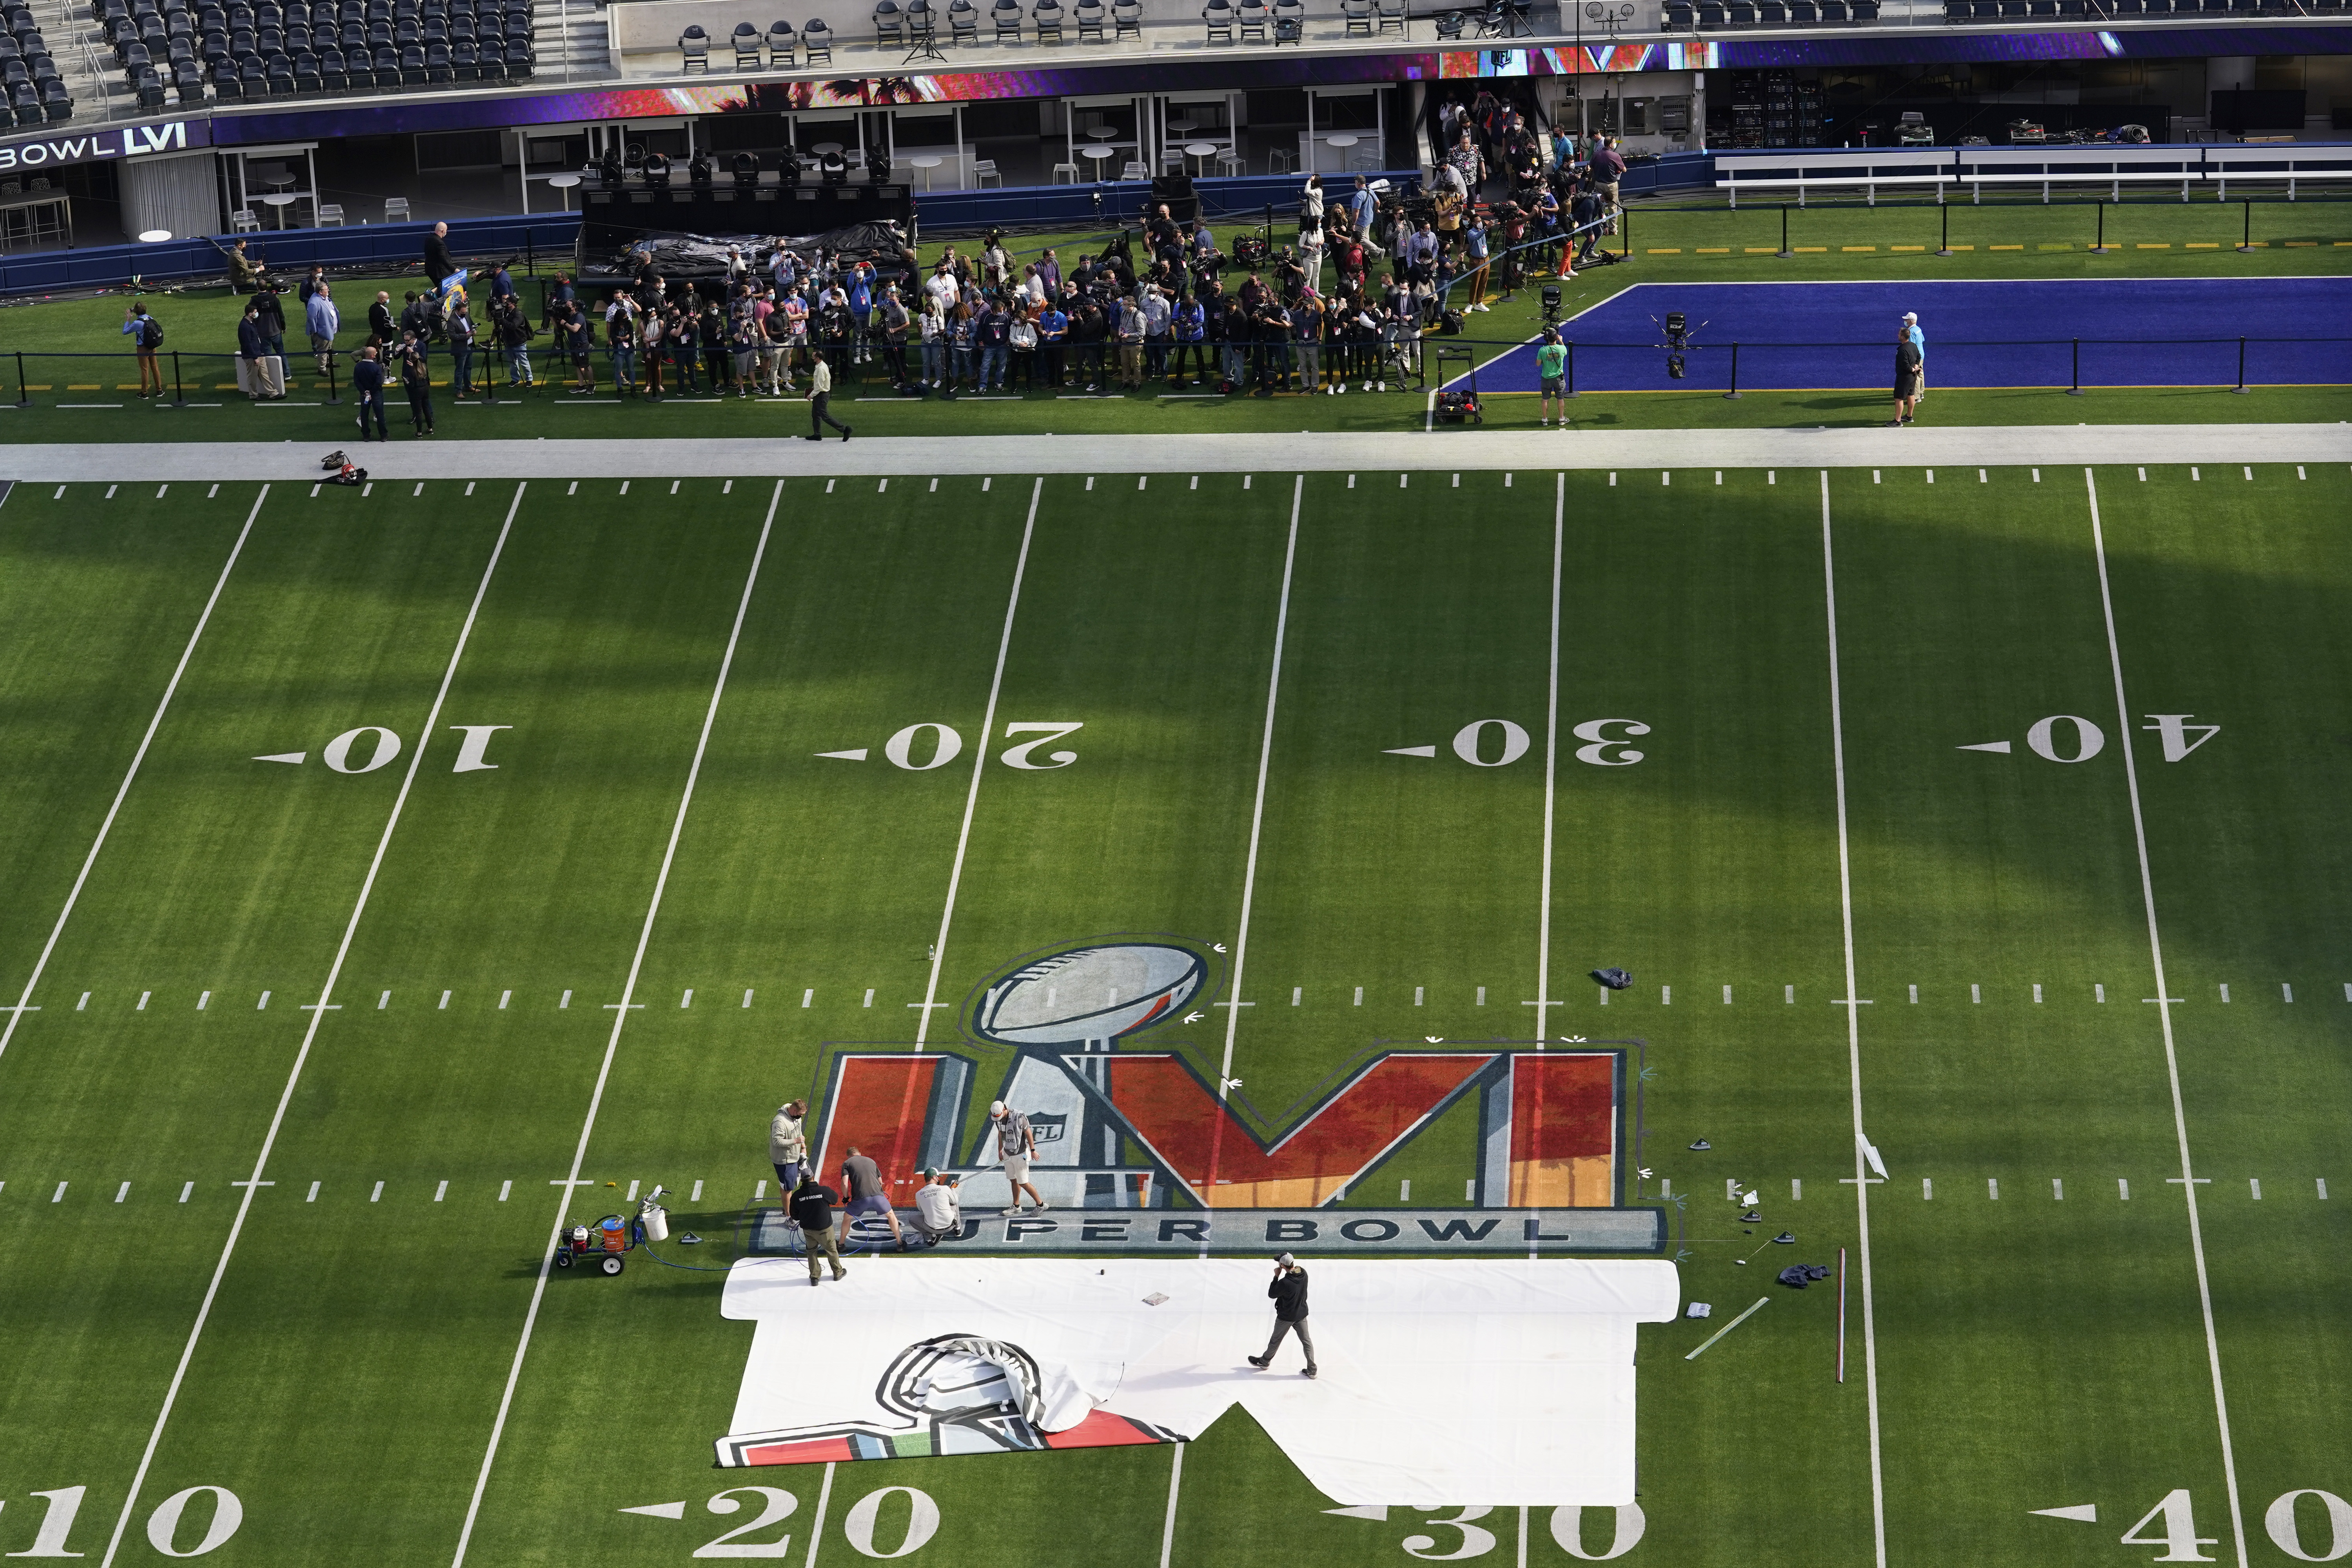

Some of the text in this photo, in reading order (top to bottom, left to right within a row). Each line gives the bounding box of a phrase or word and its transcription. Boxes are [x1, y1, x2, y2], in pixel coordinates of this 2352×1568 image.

[123, 122, 186, 156] LVI
[1029, 1126, 1058, 1141] FL
[1263, 1218, 1571, 1243] BOWL
